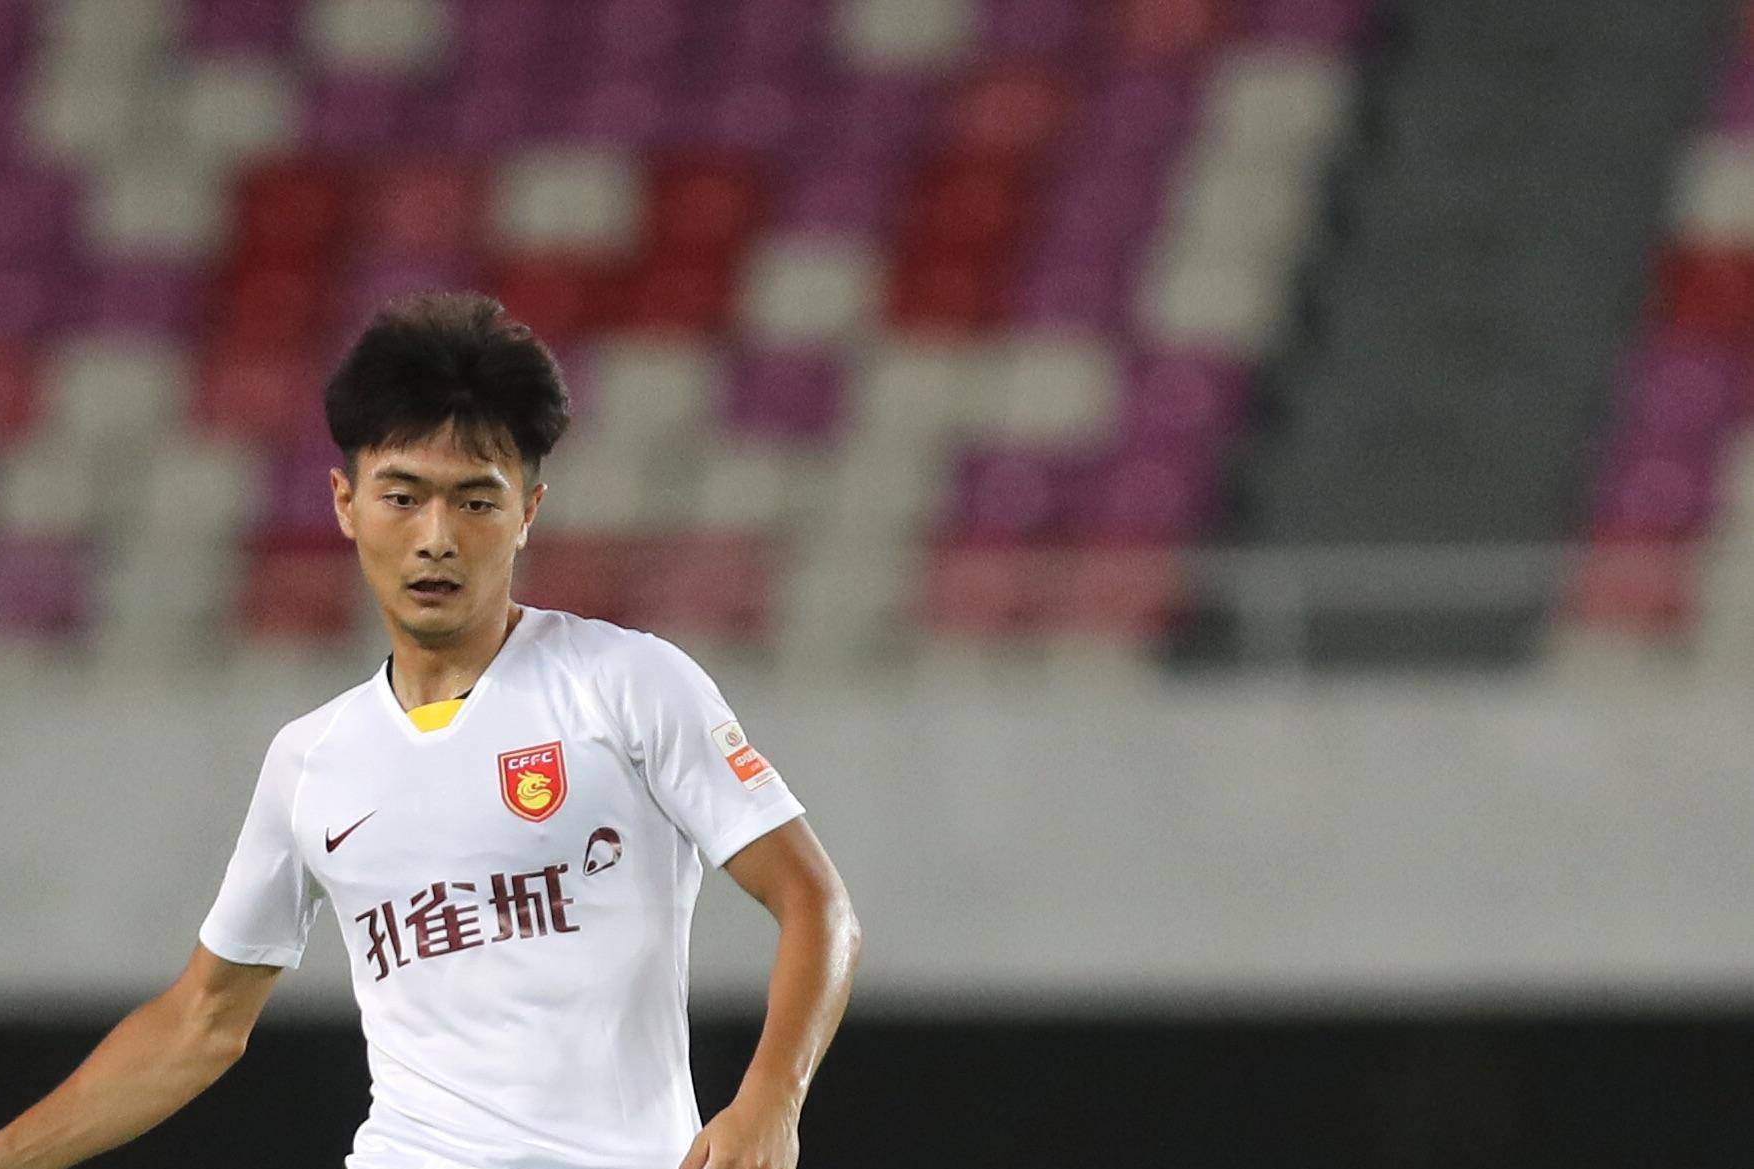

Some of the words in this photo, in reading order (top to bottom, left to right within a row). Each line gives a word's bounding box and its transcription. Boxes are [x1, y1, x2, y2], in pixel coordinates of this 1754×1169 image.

[508, 751, 553, 770] CFFC
[355, 863, 581, 982] 孔雀城
